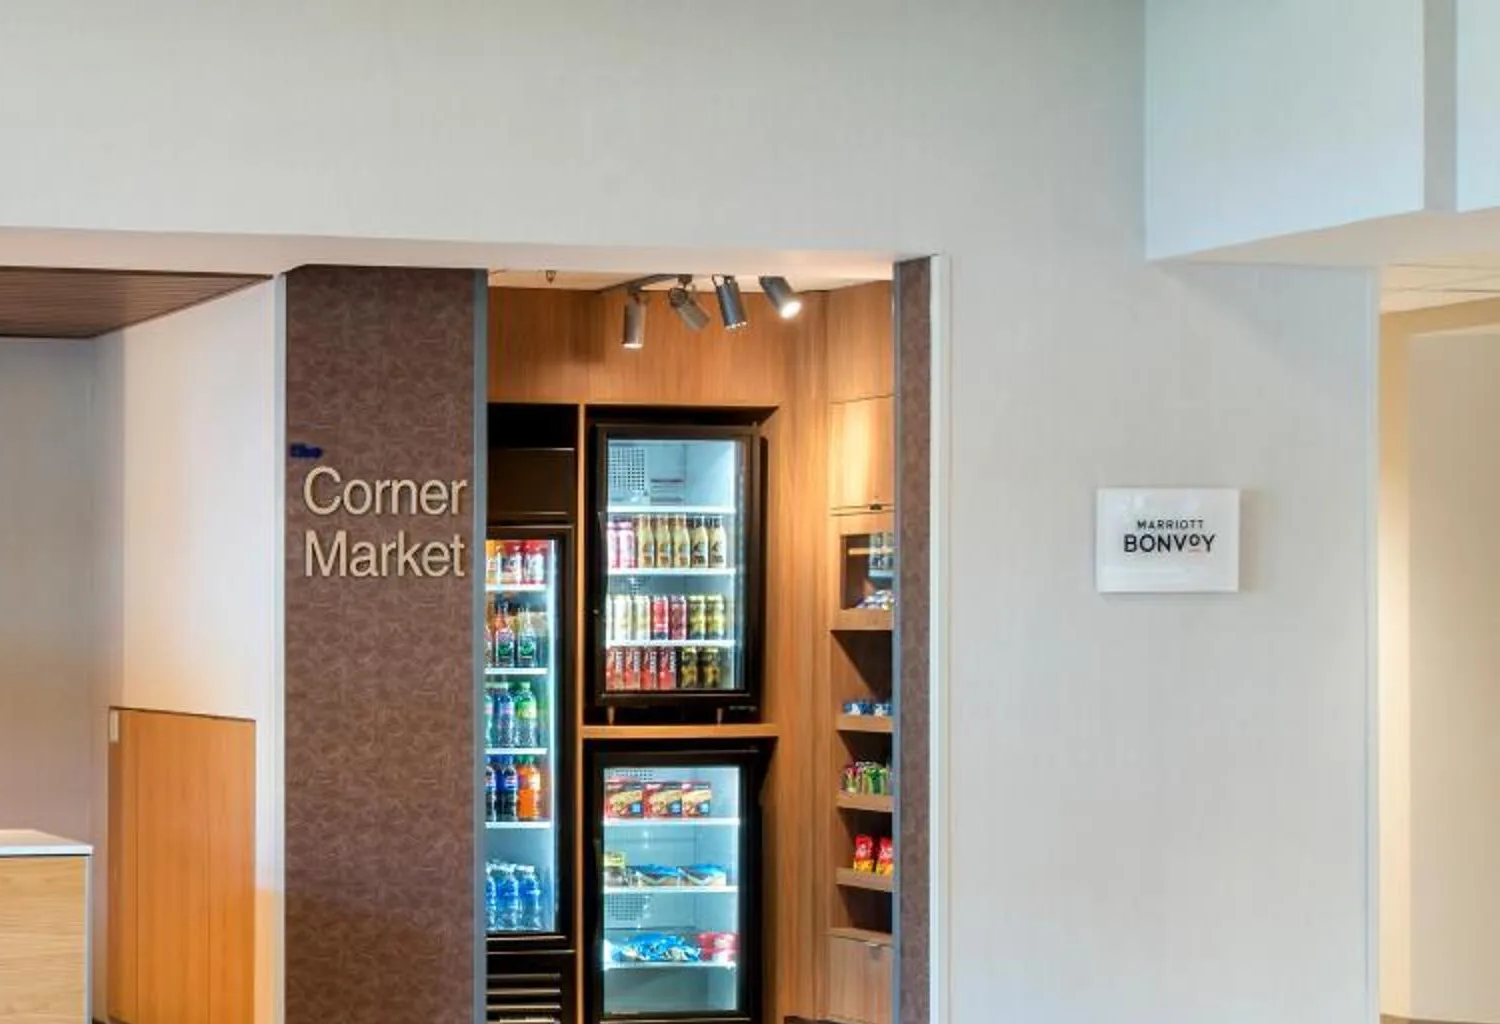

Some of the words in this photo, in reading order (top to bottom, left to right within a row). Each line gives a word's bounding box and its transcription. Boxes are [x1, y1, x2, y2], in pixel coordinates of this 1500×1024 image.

[303, 465, 468, 516] Corner
[1136, 519, 1205, 530] MARRIOTT
[304, 529, 466, 578] Market
